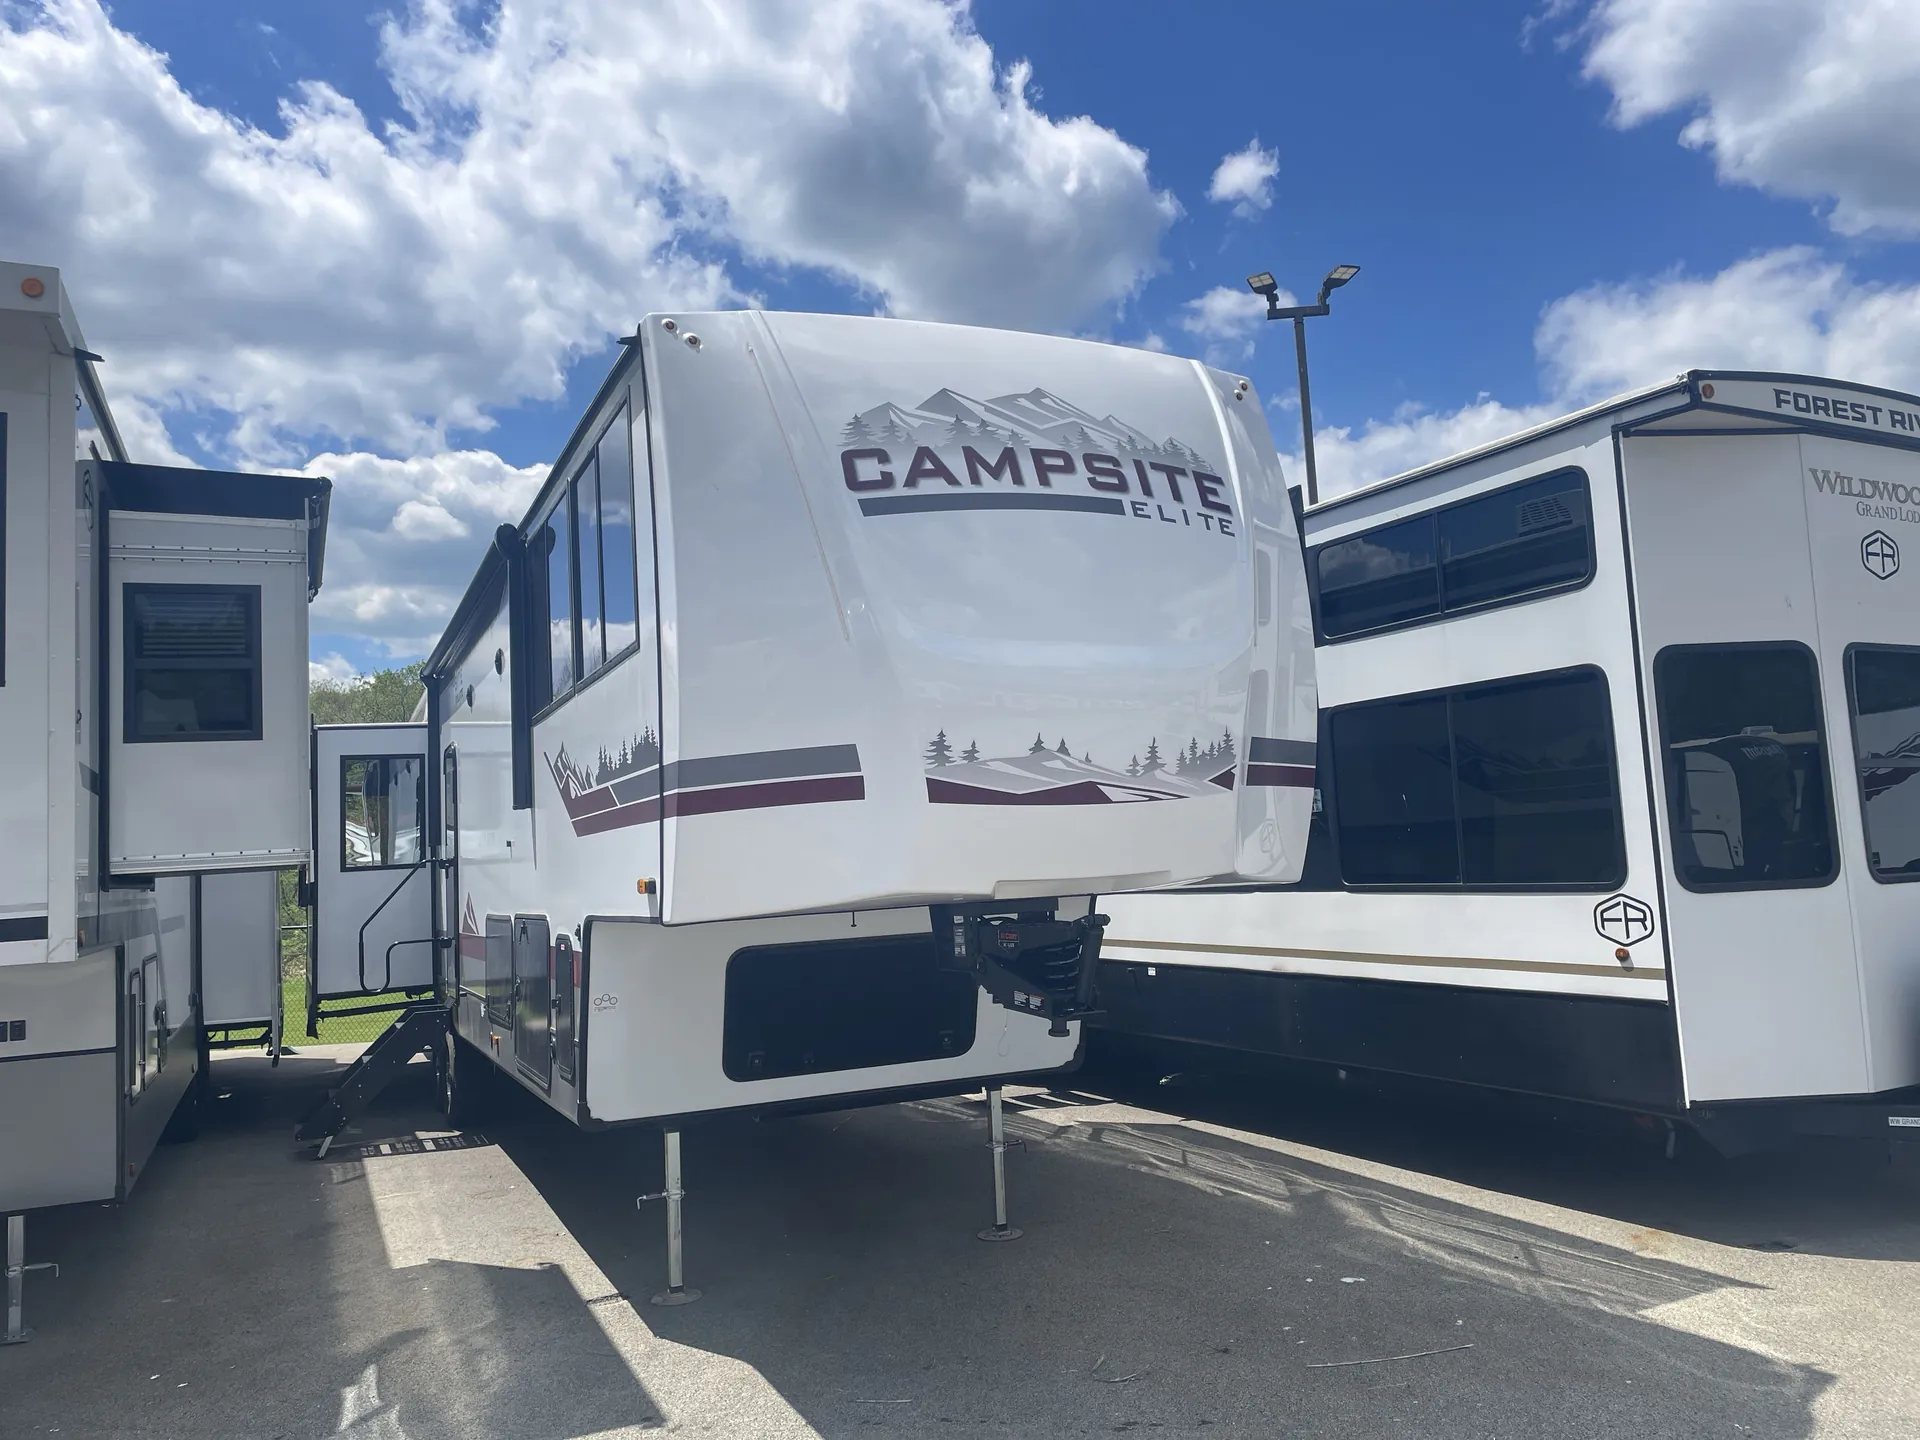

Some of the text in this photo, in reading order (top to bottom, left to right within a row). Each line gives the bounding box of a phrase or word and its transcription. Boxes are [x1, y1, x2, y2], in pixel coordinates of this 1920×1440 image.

[1772, 388, 1883, 425] FOREST
[840, 445, 1233, 515] CAMPSITE
[1130, 500, 1236, 537] ELITE
[1856, 501, 1898, 520] GRAND
[1599, 900, 1648, 939] FR
